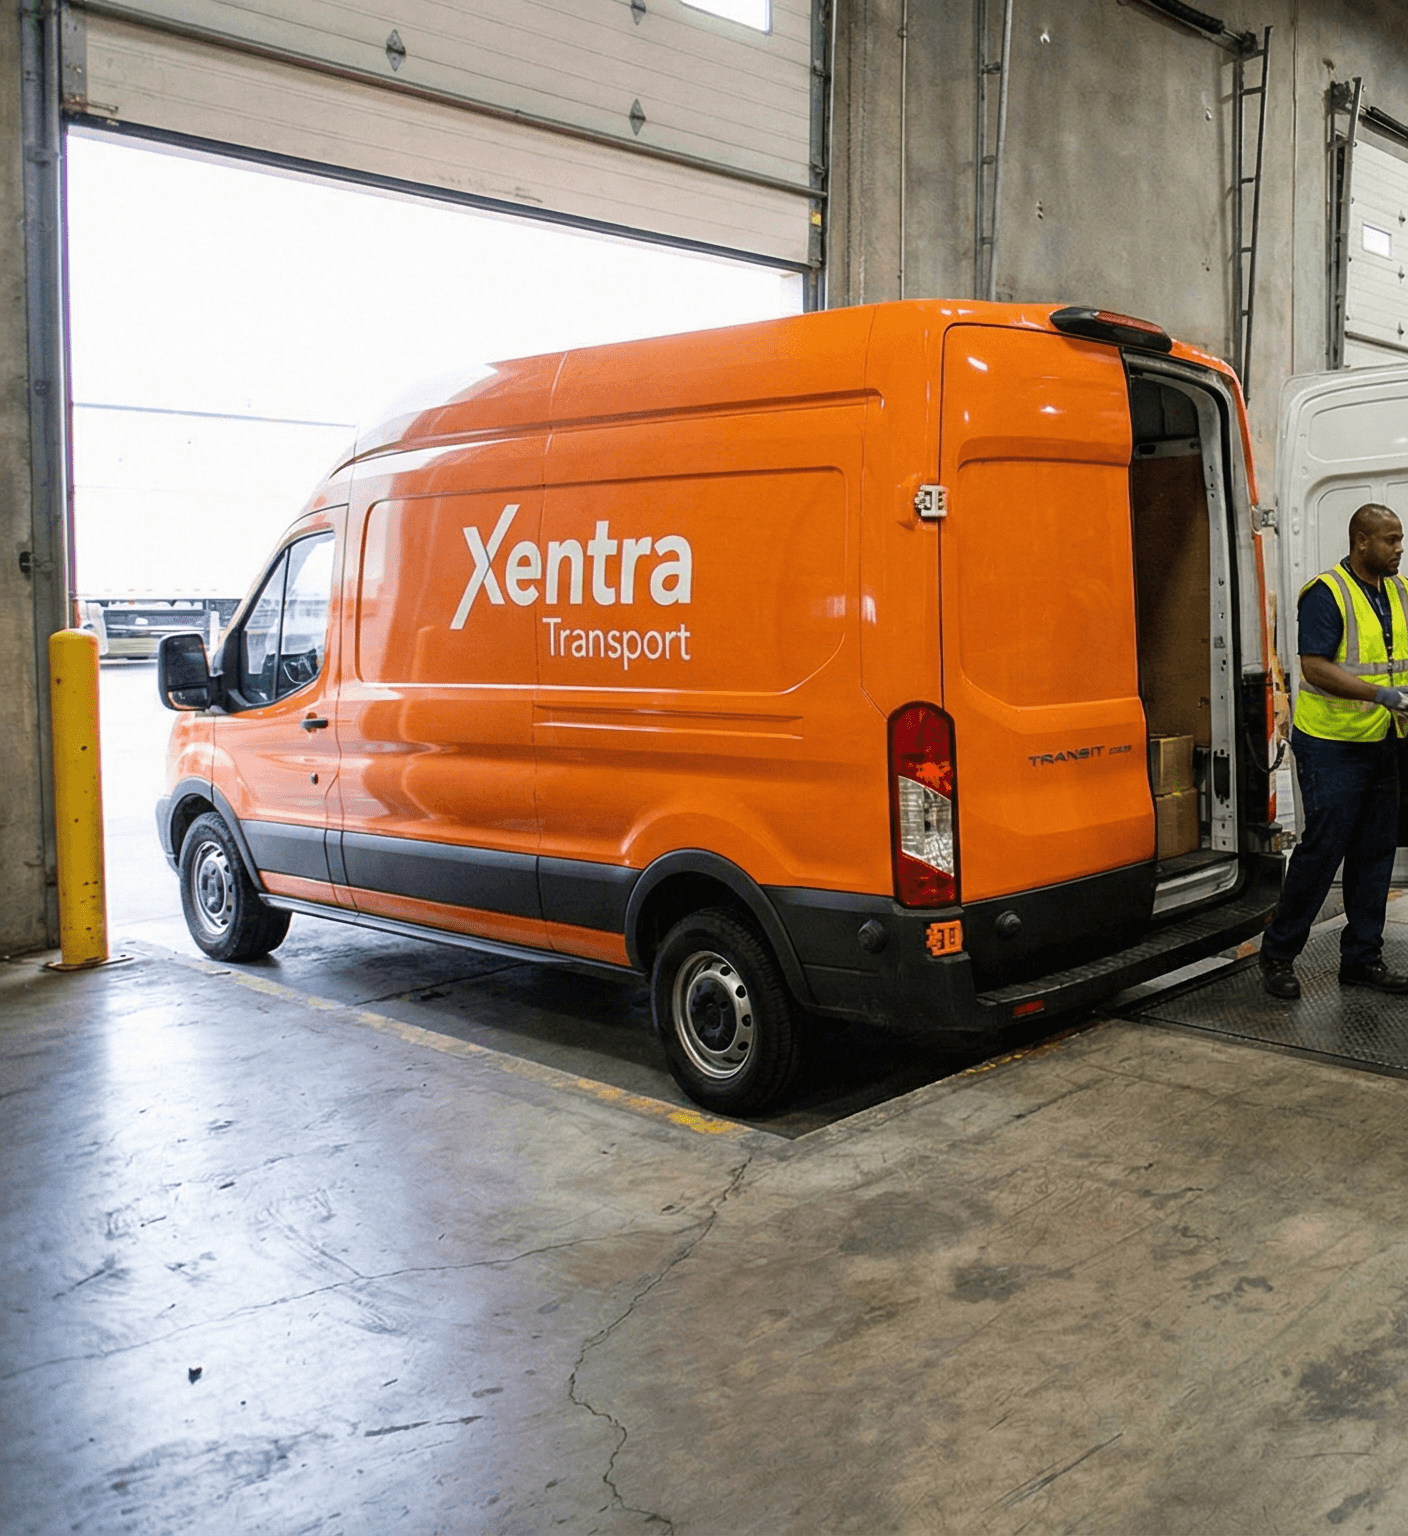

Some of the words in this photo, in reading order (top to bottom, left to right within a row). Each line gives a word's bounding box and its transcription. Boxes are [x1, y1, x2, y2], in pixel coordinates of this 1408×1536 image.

[450, 504, 693, 630] Xentra
[542, 617, 691, 670] Transport
[1028, 745, 1105, 767] TRANSIT
